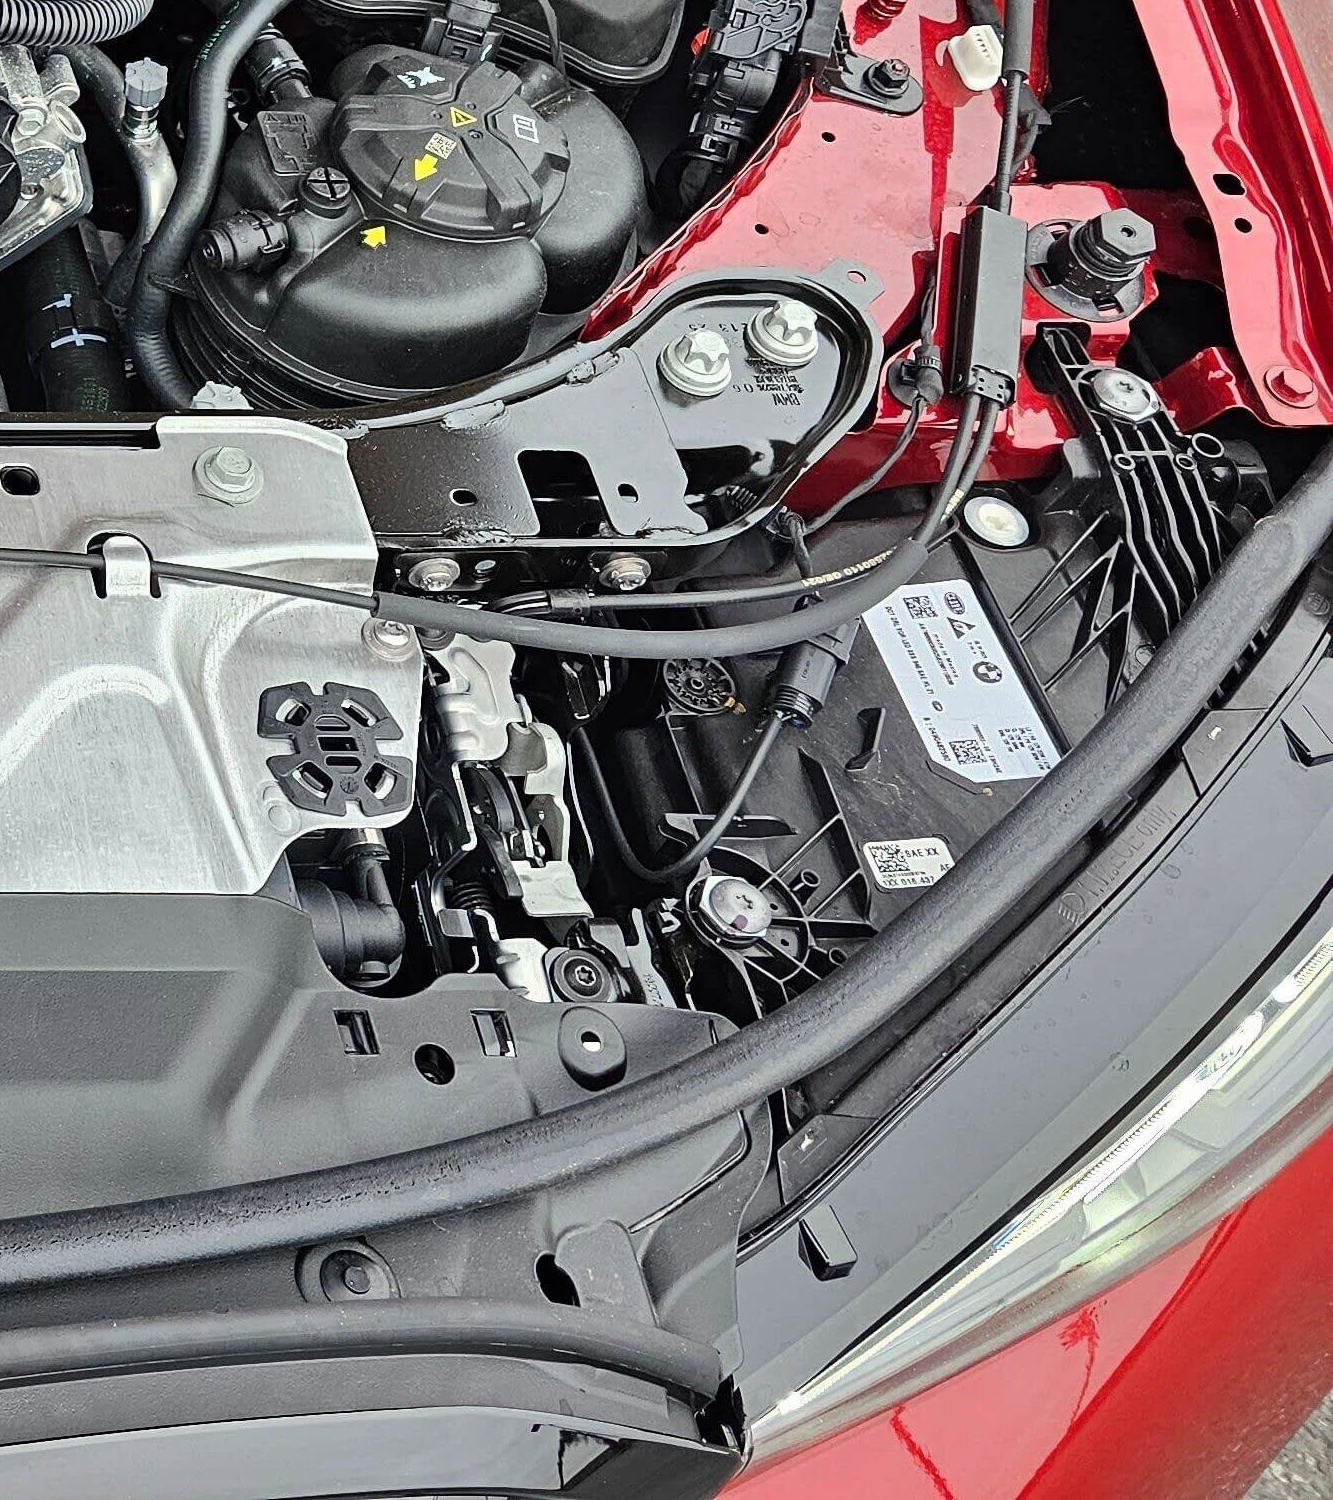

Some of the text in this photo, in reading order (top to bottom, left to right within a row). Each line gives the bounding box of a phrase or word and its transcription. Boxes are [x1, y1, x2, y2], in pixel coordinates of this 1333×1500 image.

[771, 393, 800, 405] BMW
[905, 847, 939, 857] SAE XX
